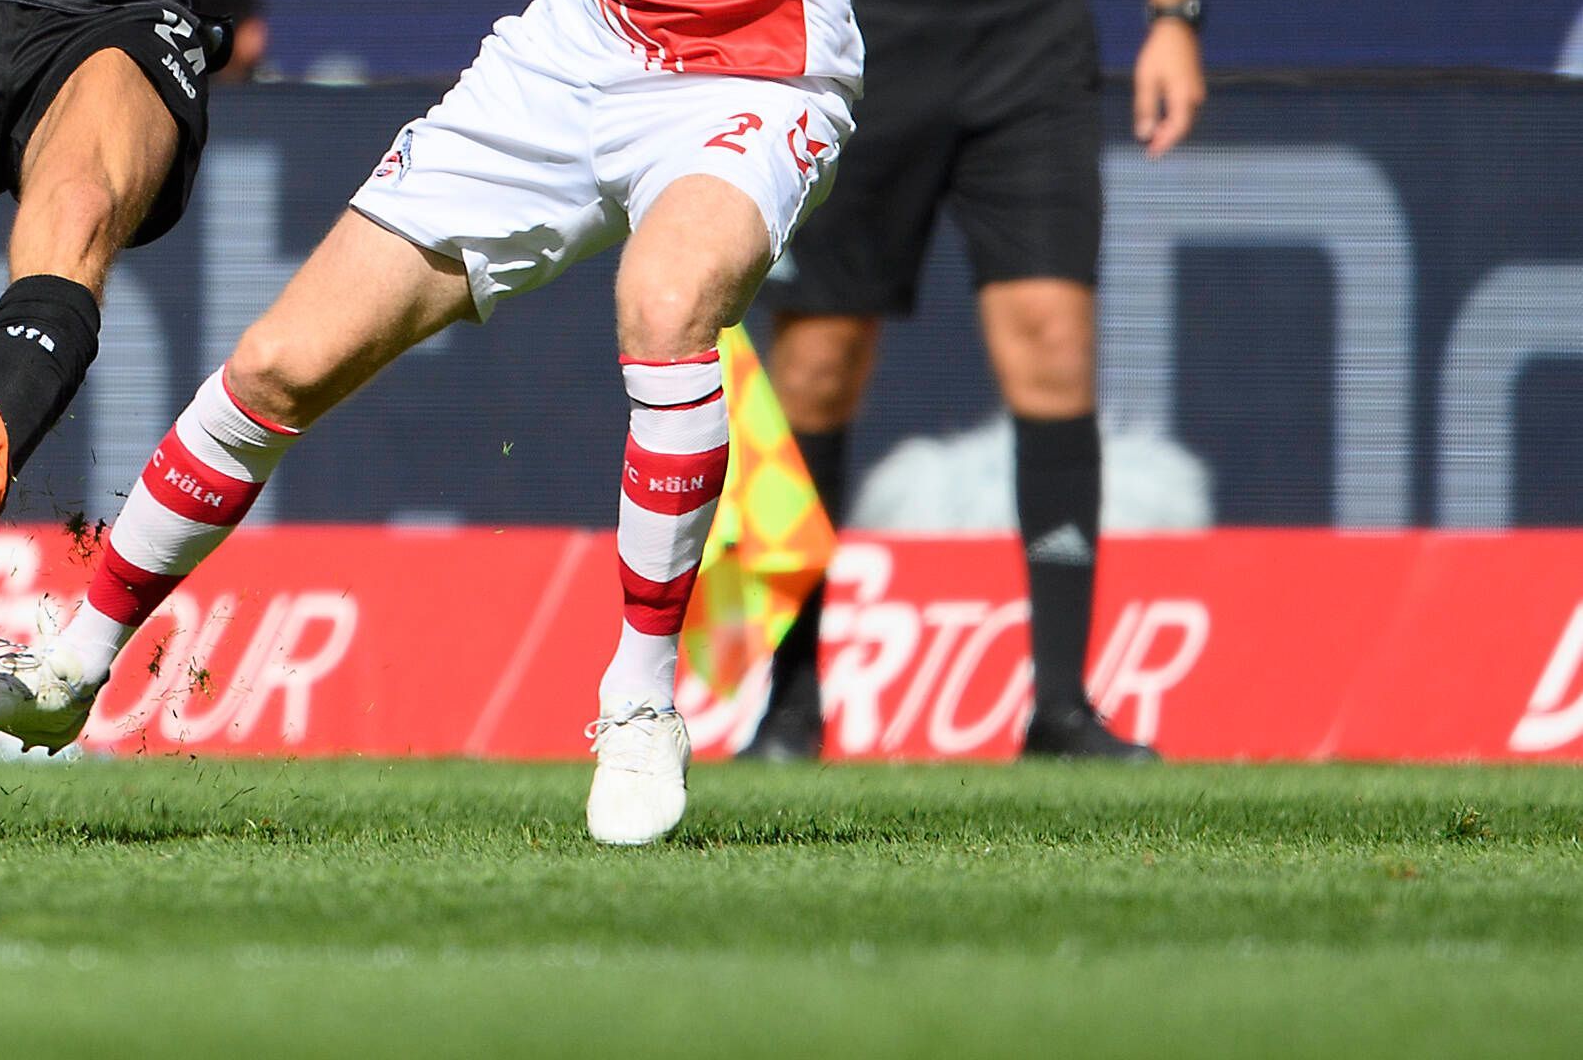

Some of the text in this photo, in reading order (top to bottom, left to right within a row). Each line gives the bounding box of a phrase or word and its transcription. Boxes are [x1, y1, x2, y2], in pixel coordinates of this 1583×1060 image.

[161, 53, 197, 99] JAKO
[164, 467, 223, 507] KÖLN
[648, 475, 705, 493] KÖLN
